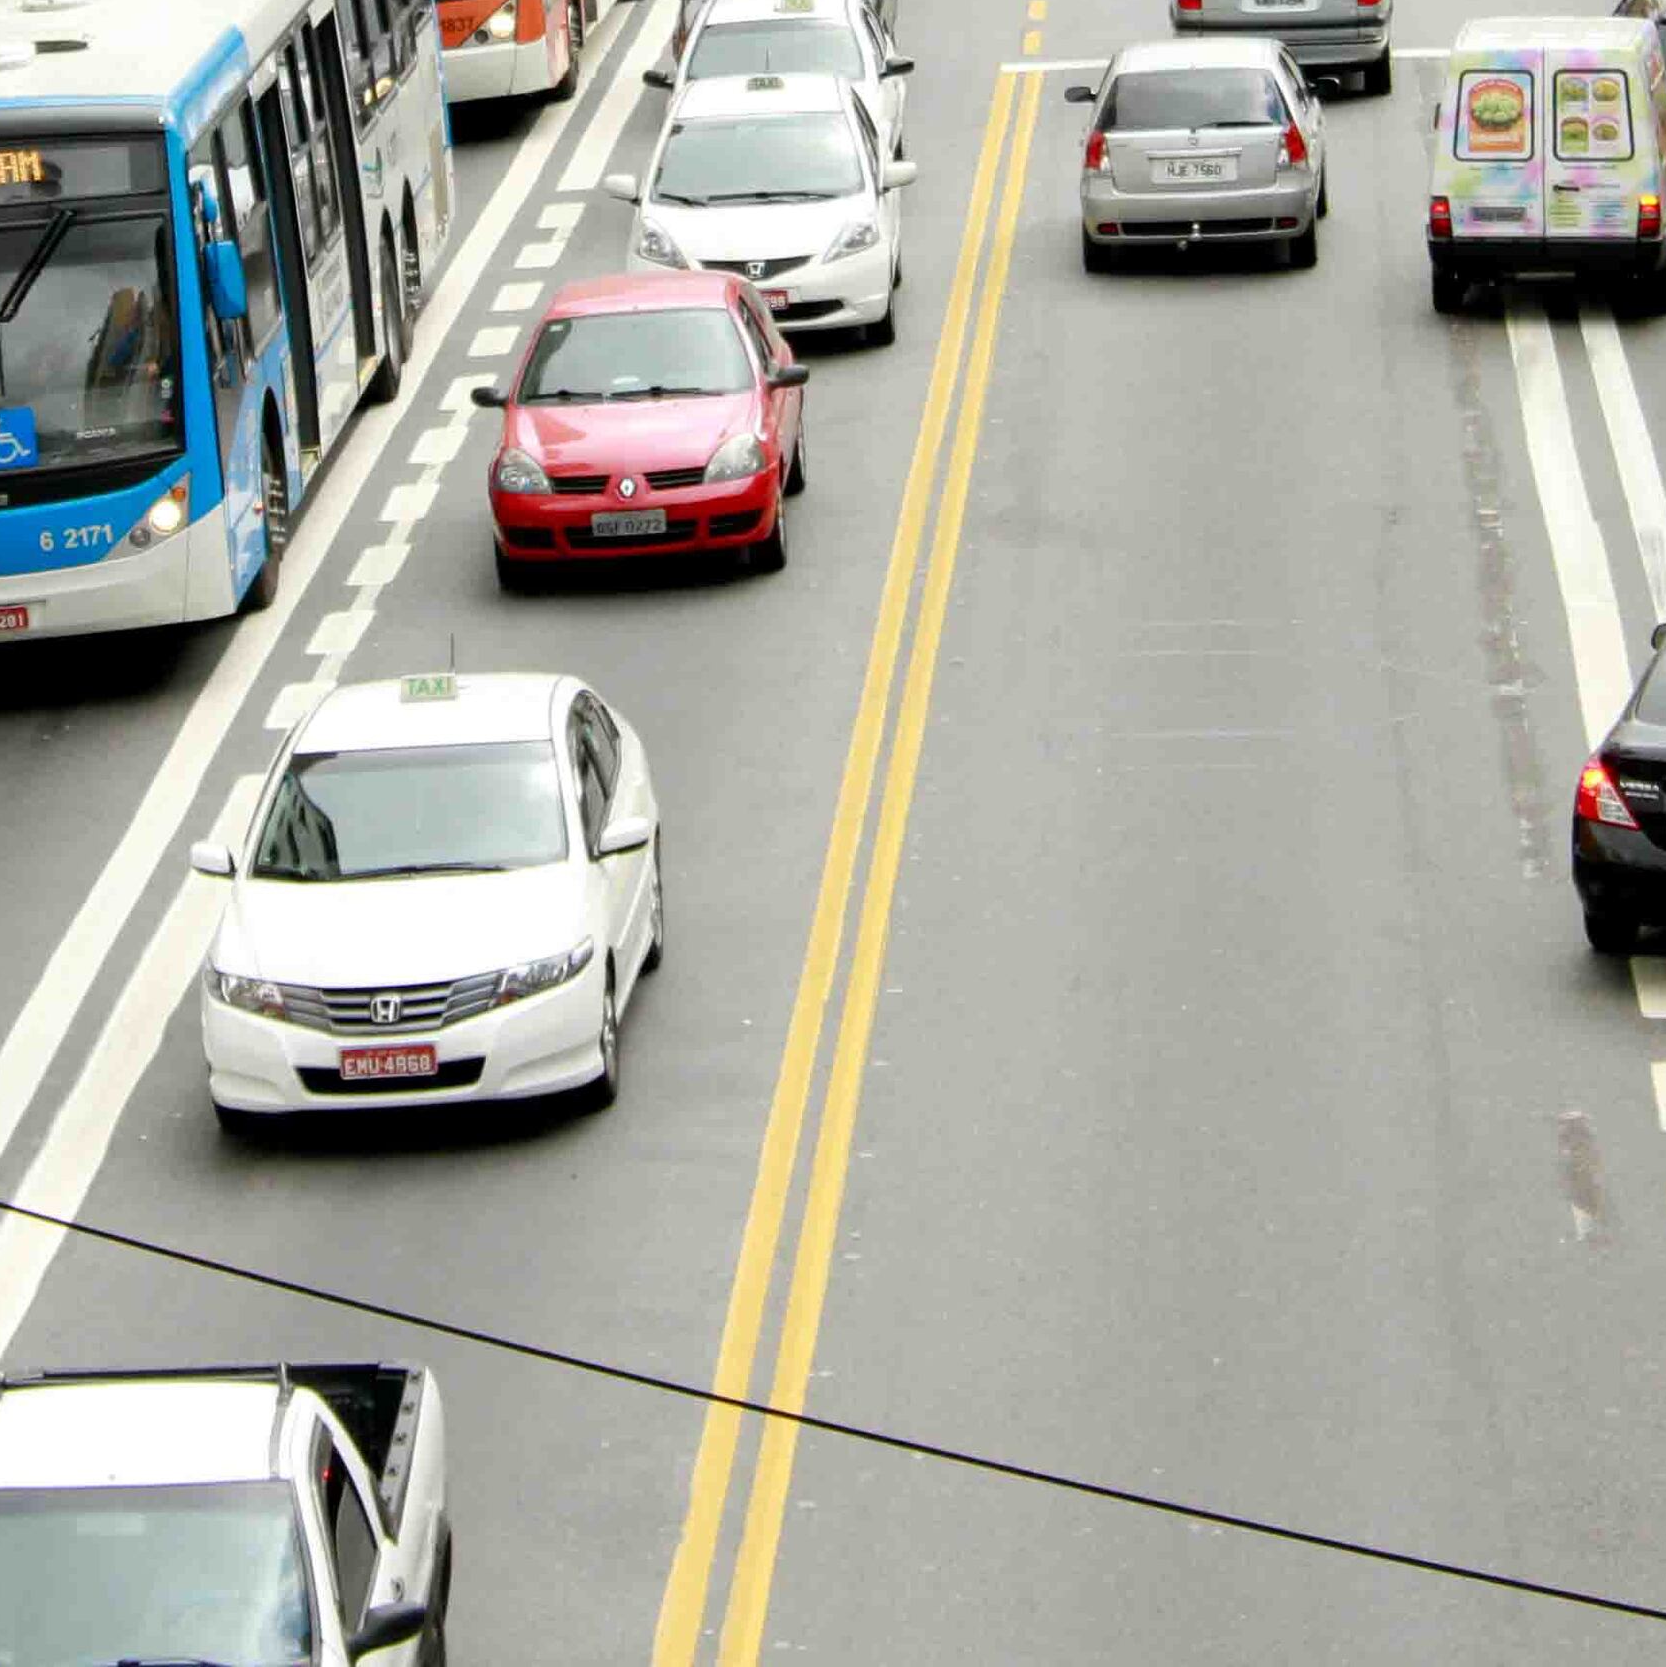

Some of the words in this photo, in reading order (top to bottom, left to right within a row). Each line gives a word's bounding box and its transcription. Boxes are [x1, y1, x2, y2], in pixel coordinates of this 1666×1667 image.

[39, 532, 55, 552] 6
[64, 525, 114, 549] 2171
[406, 676, 453, 697] TAXI
